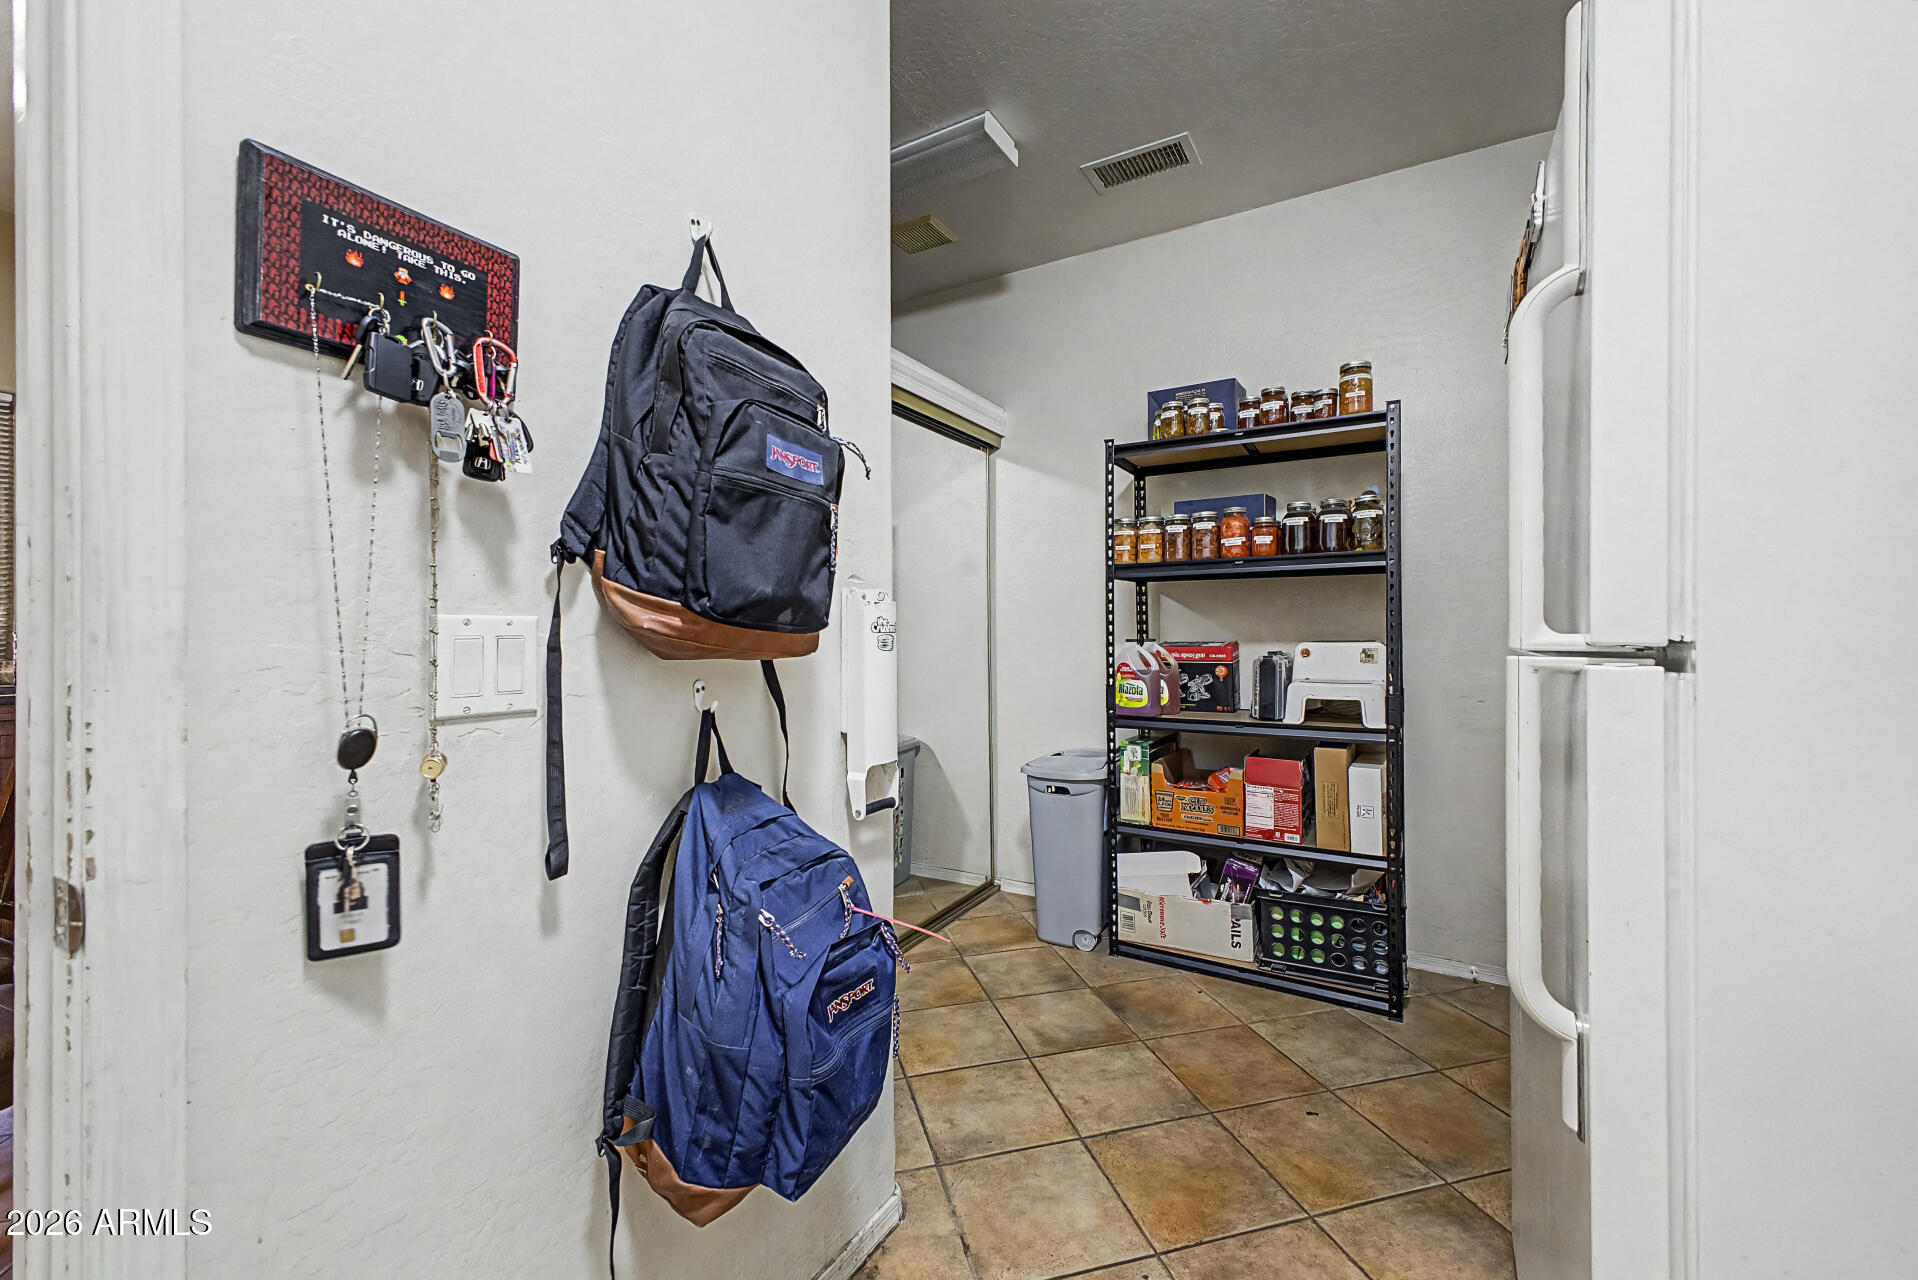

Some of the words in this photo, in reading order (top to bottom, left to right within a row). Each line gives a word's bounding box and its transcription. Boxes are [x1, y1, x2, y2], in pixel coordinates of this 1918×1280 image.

[322, 213, 356, 235] IT'S
[363, 230, 434, 265] DANGEROUS
[440, 260, 456, 273] TO
[460, 269, 476, 281] GO
[336, 228, 387, 254] ALONE!
[396, 250, 427, 270] TAKE
[433, 264, 467, 285] THIS.
[1230, 919, 1242, 950] AILS
